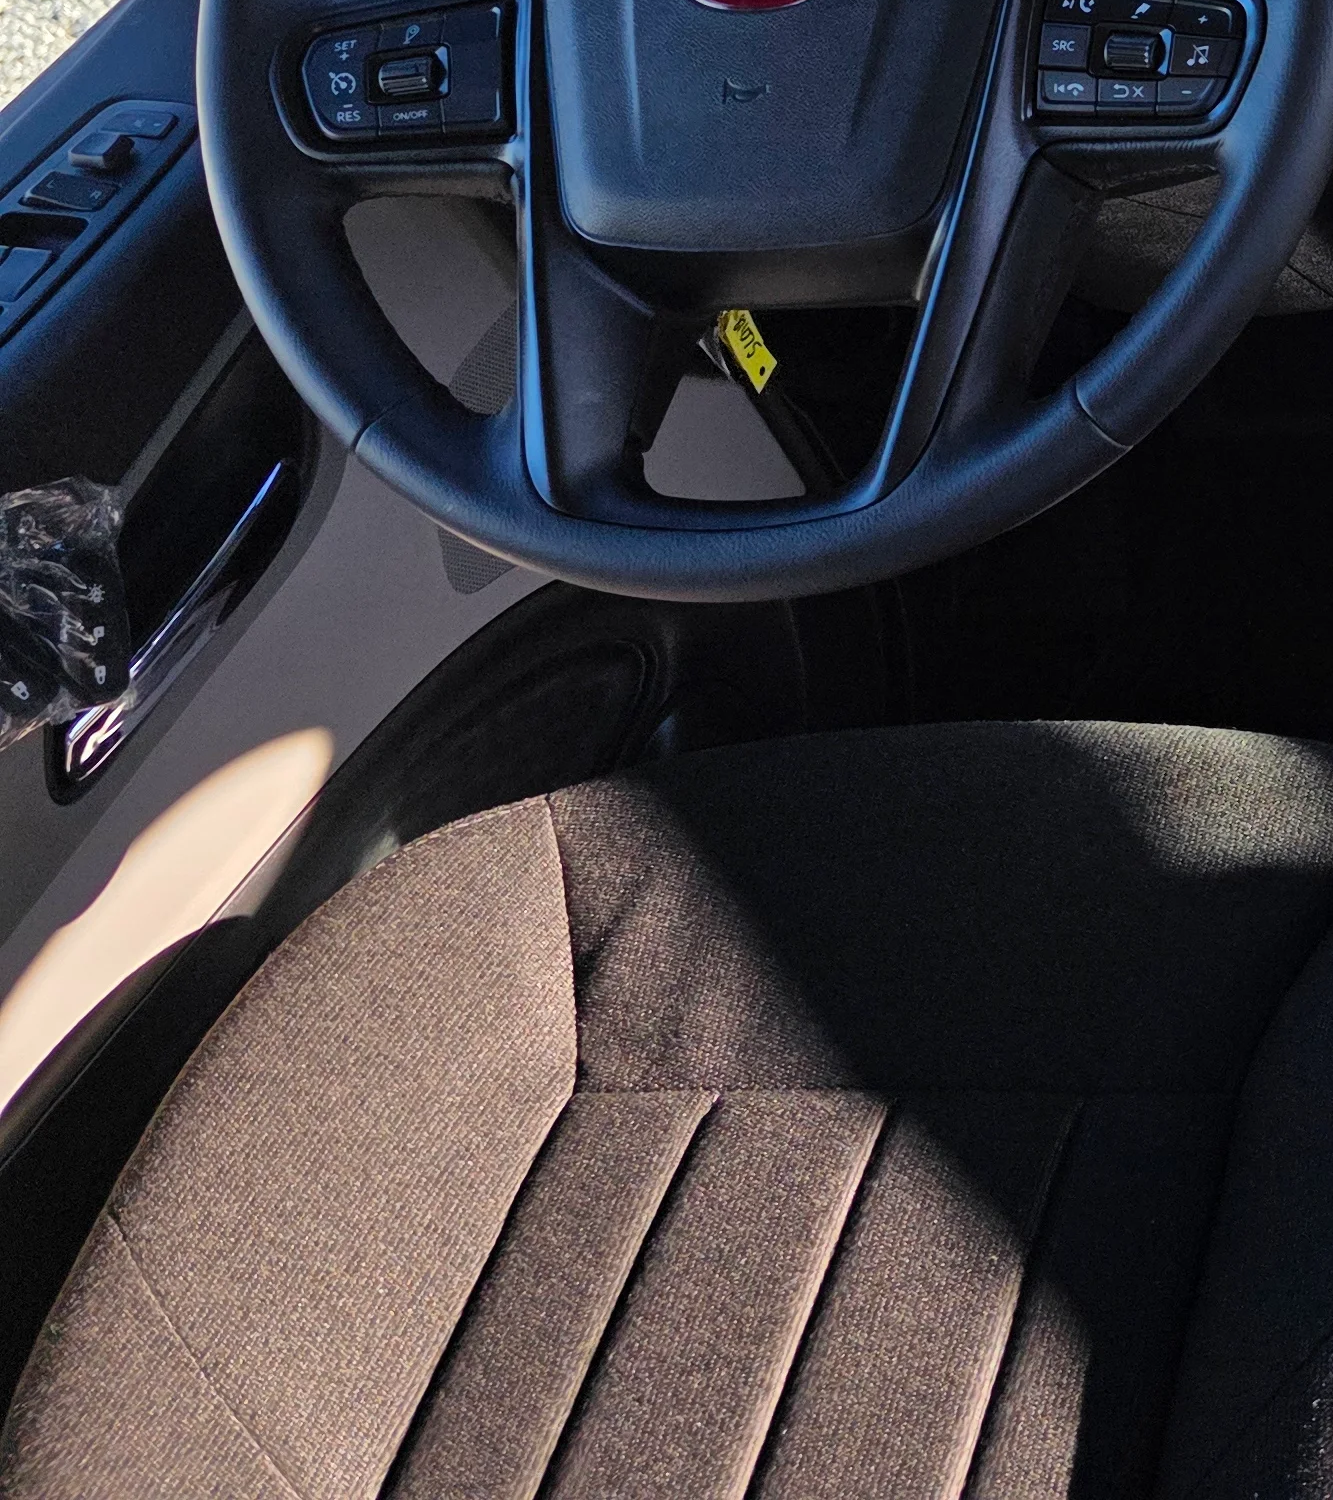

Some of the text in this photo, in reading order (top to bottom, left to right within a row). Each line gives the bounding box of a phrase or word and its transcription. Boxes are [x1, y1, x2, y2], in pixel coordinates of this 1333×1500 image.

[334, 39, 358, 51] SET
[1052, 40, 1076, 52] SRC
[336, 110, 361, 122] RES
[393, 109, 428, 122] ON/OFF
